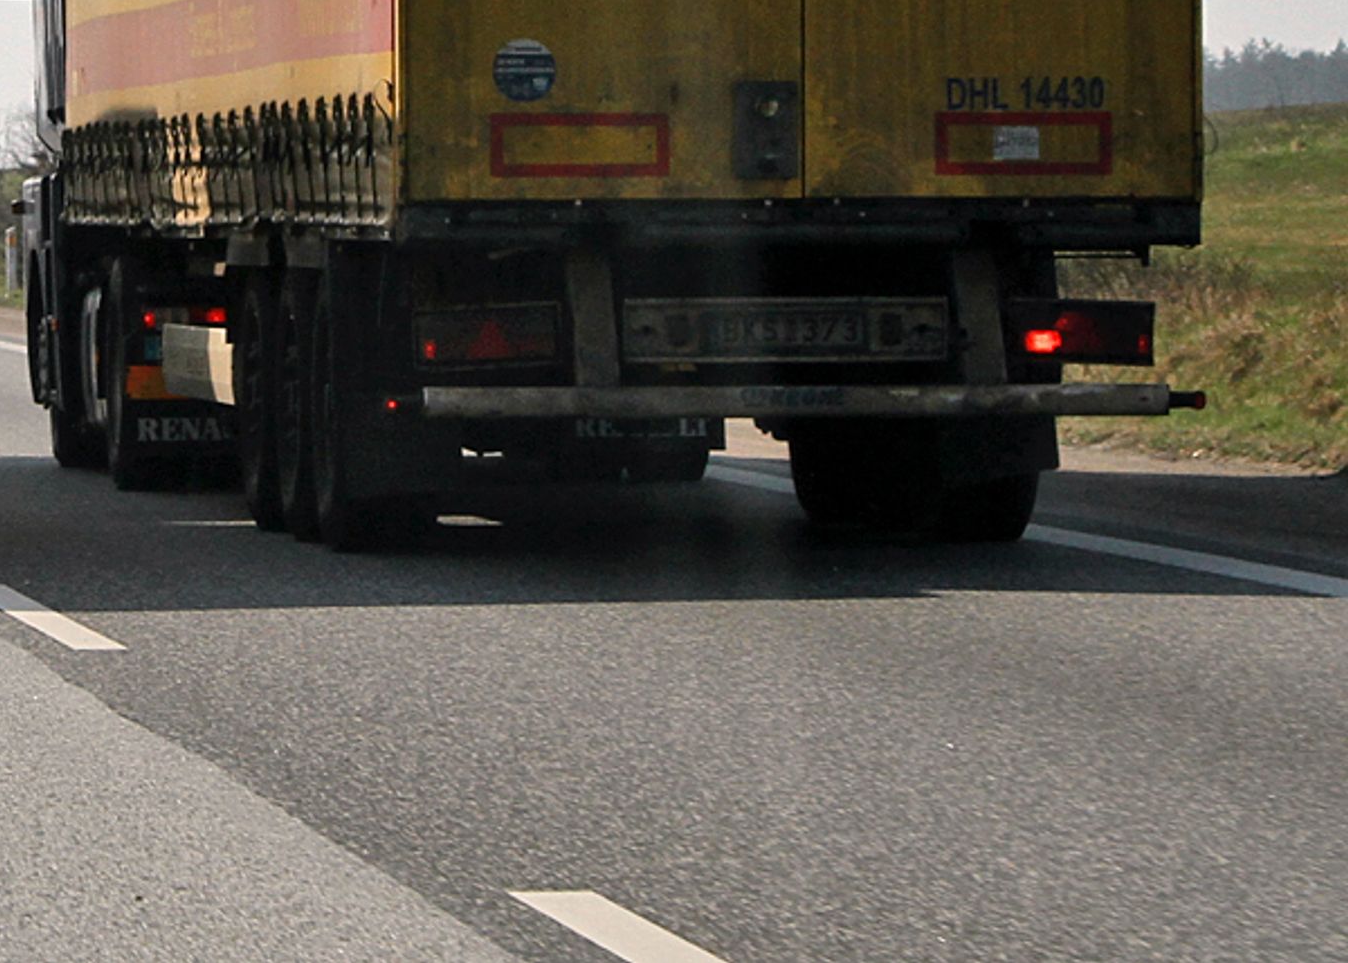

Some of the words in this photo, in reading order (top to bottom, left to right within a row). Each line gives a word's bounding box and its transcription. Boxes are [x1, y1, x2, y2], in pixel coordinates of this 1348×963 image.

[946, 76, 1009, 110] DHL
[1019, 75, 1105, 109] 14430
[136, 416, 232, 442] RENA
